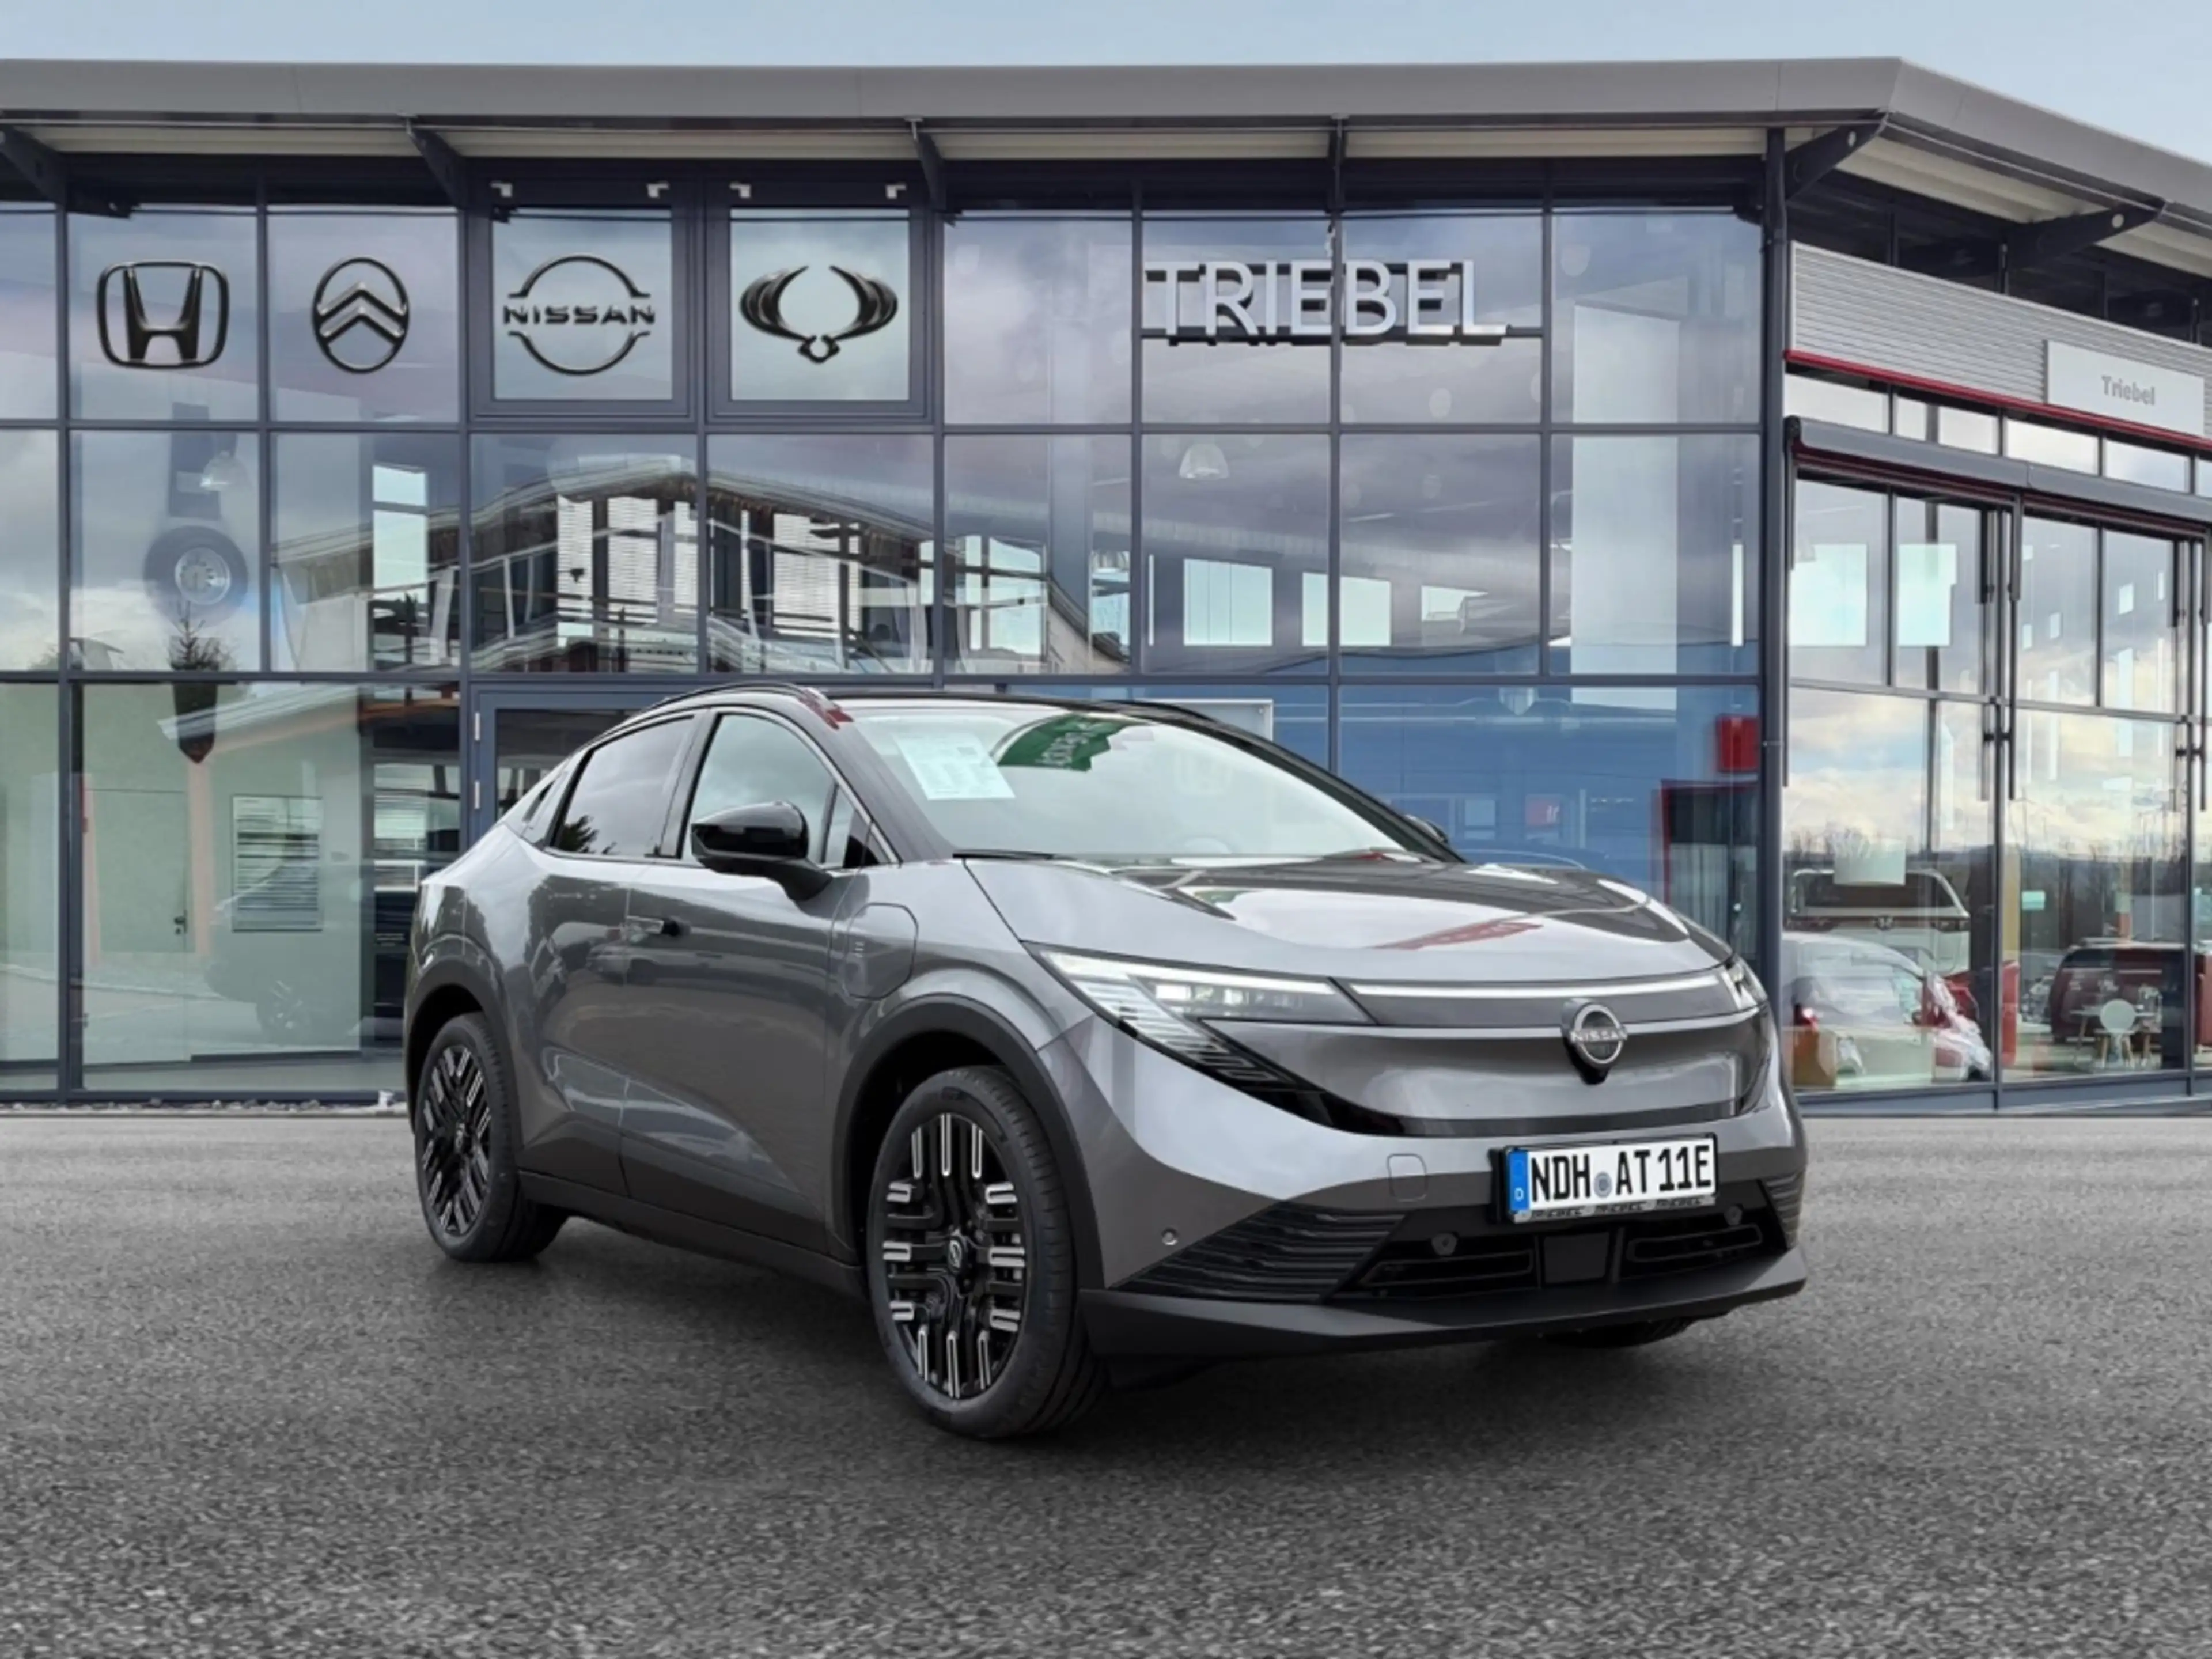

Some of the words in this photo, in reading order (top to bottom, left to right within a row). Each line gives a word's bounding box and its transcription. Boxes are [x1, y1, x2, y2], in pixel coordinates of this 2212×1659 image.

[503, 305, 655, 325] NISSAN
[1144, 259, 1507, 336] TRIEBEL
[2101, 375, 2155, 406] Triebel
[1515, 1188, 1524, 1201] D
[1531, 1153, 1590, 1202] NDH
